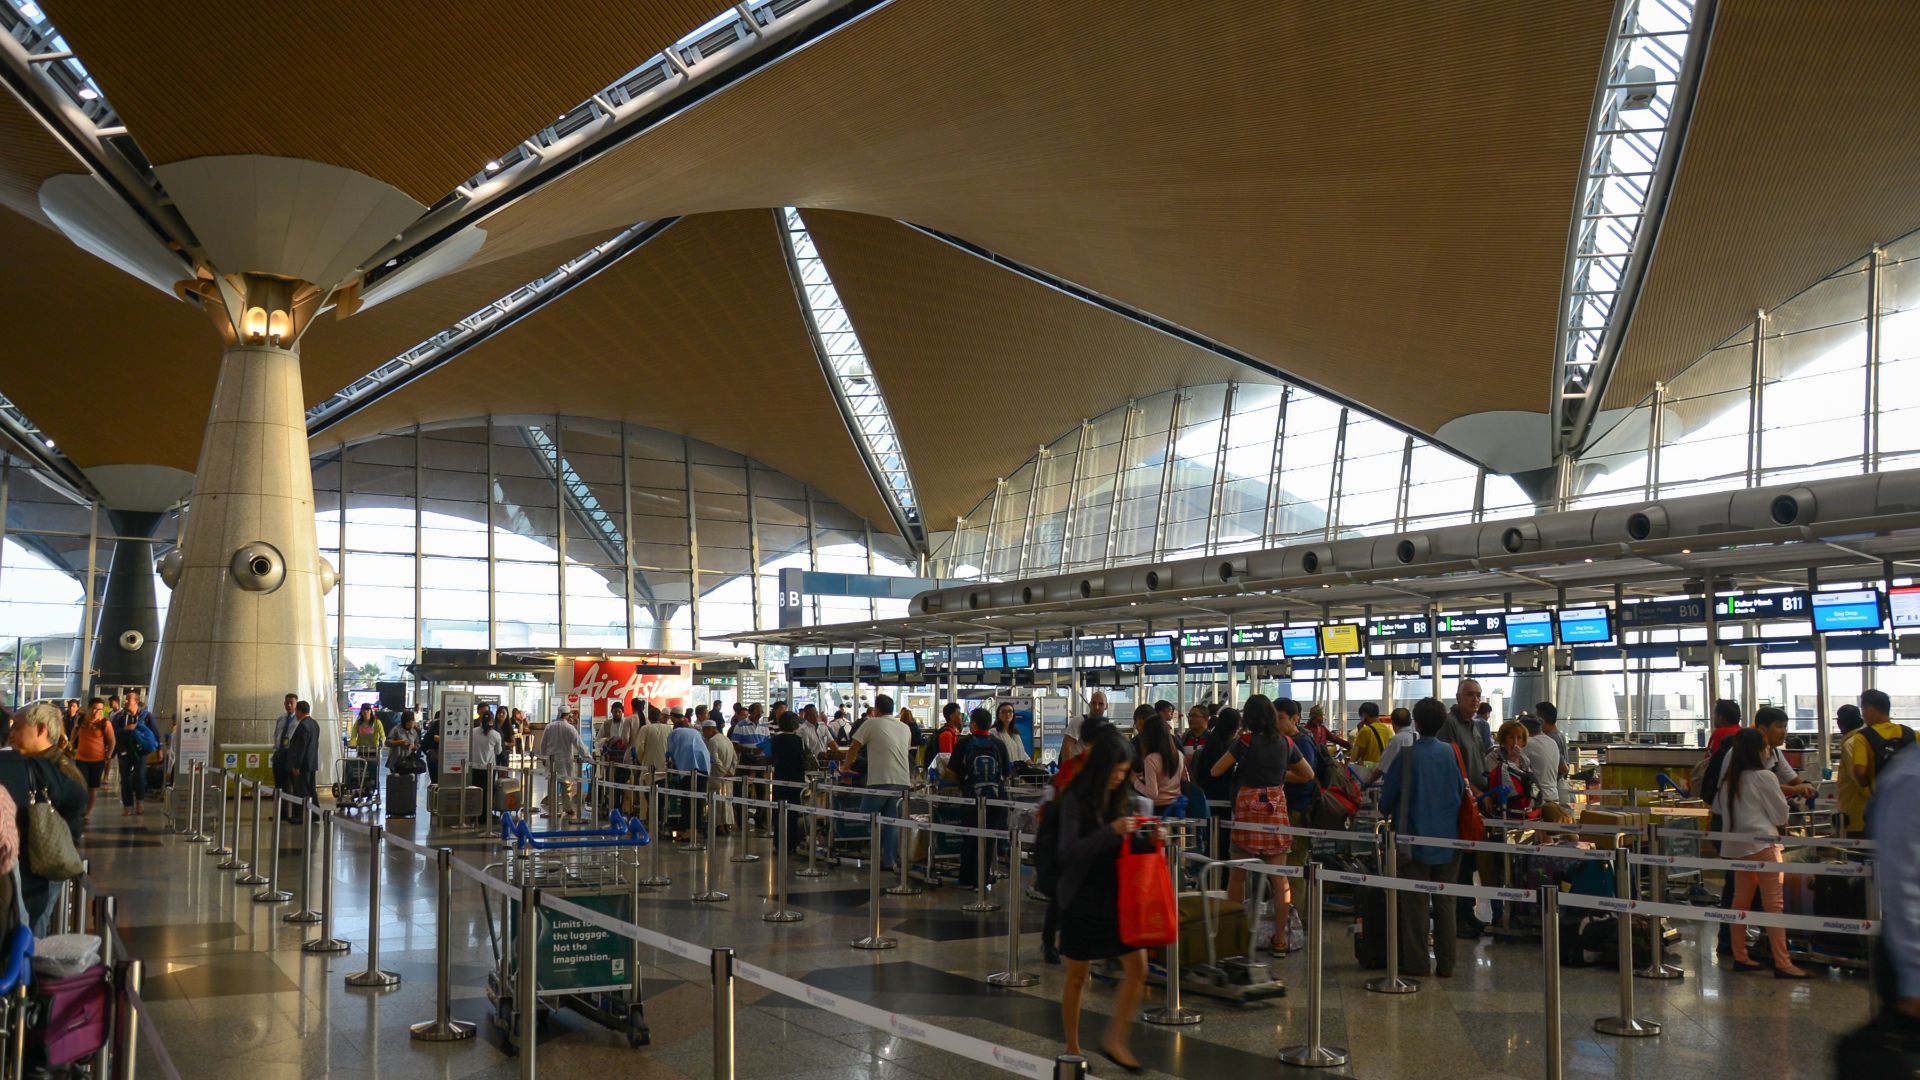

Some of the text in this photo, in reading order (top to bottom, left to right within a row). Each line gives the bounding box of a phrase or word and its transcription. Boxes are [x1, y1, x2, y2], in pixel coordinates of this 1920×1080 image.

[779, 591, 786, 607] B
[789, 591, 800, 607] B
[1782, 596, 1803, 611] B11
[1679, 604, 1699, 617] B10
[1413, 622, 1427, 634] B8
[1486, 617, 1500, 630] B9
[1213, 635, 1224, 645] B6
[1269, 631, 1279, 642] B7
[1061, 644, 1070, 653] B4
[1104, 642, 1112, 650] B5
[1704, 911, 1736, 920] malaysia
[553, 920, 581, 929] Limits
[1823, 921, 1860, 931] malaysia
[553, 931, 610, 940] the luggage.
[553, 943, 588, 952] Not the
[553, 954, 610, 964] imagination.
